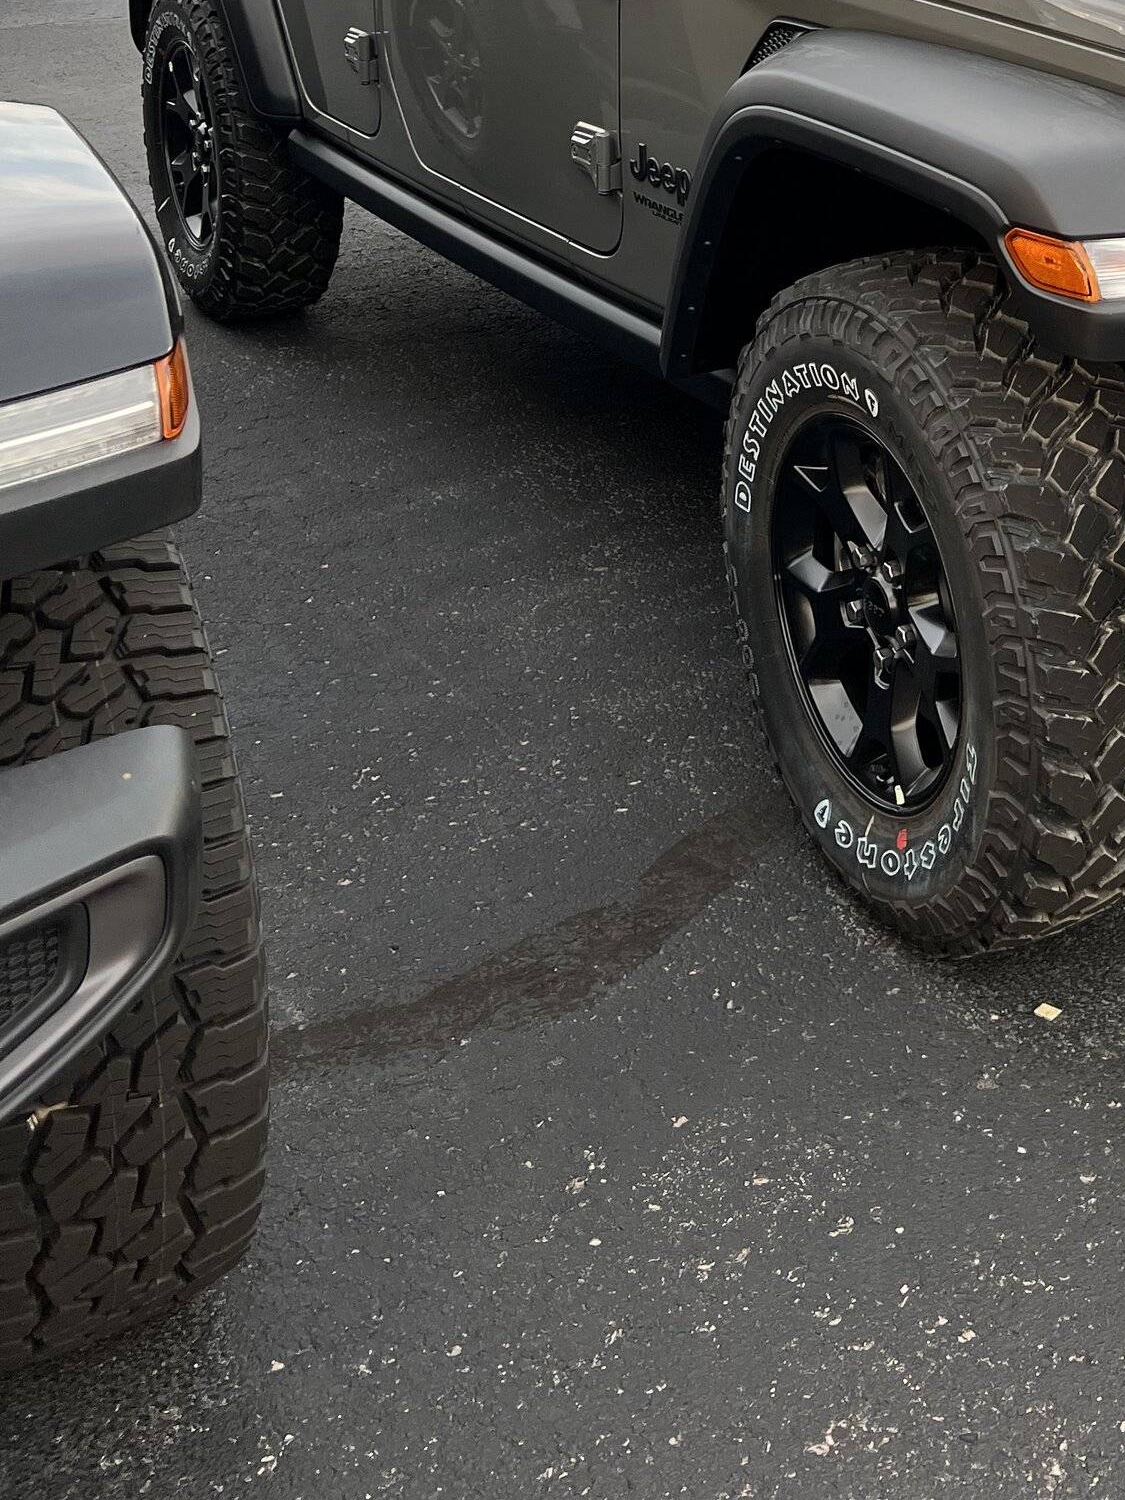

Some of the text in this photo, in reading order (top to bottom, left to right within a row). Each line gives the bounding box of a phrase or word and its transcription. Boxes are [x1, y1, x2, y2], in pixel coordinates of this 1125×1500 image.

[629, 142, 694, 207] Jeep
[734, 362, 860, 513] DESTINATION
[834, 742, 978, 881] Firestone
